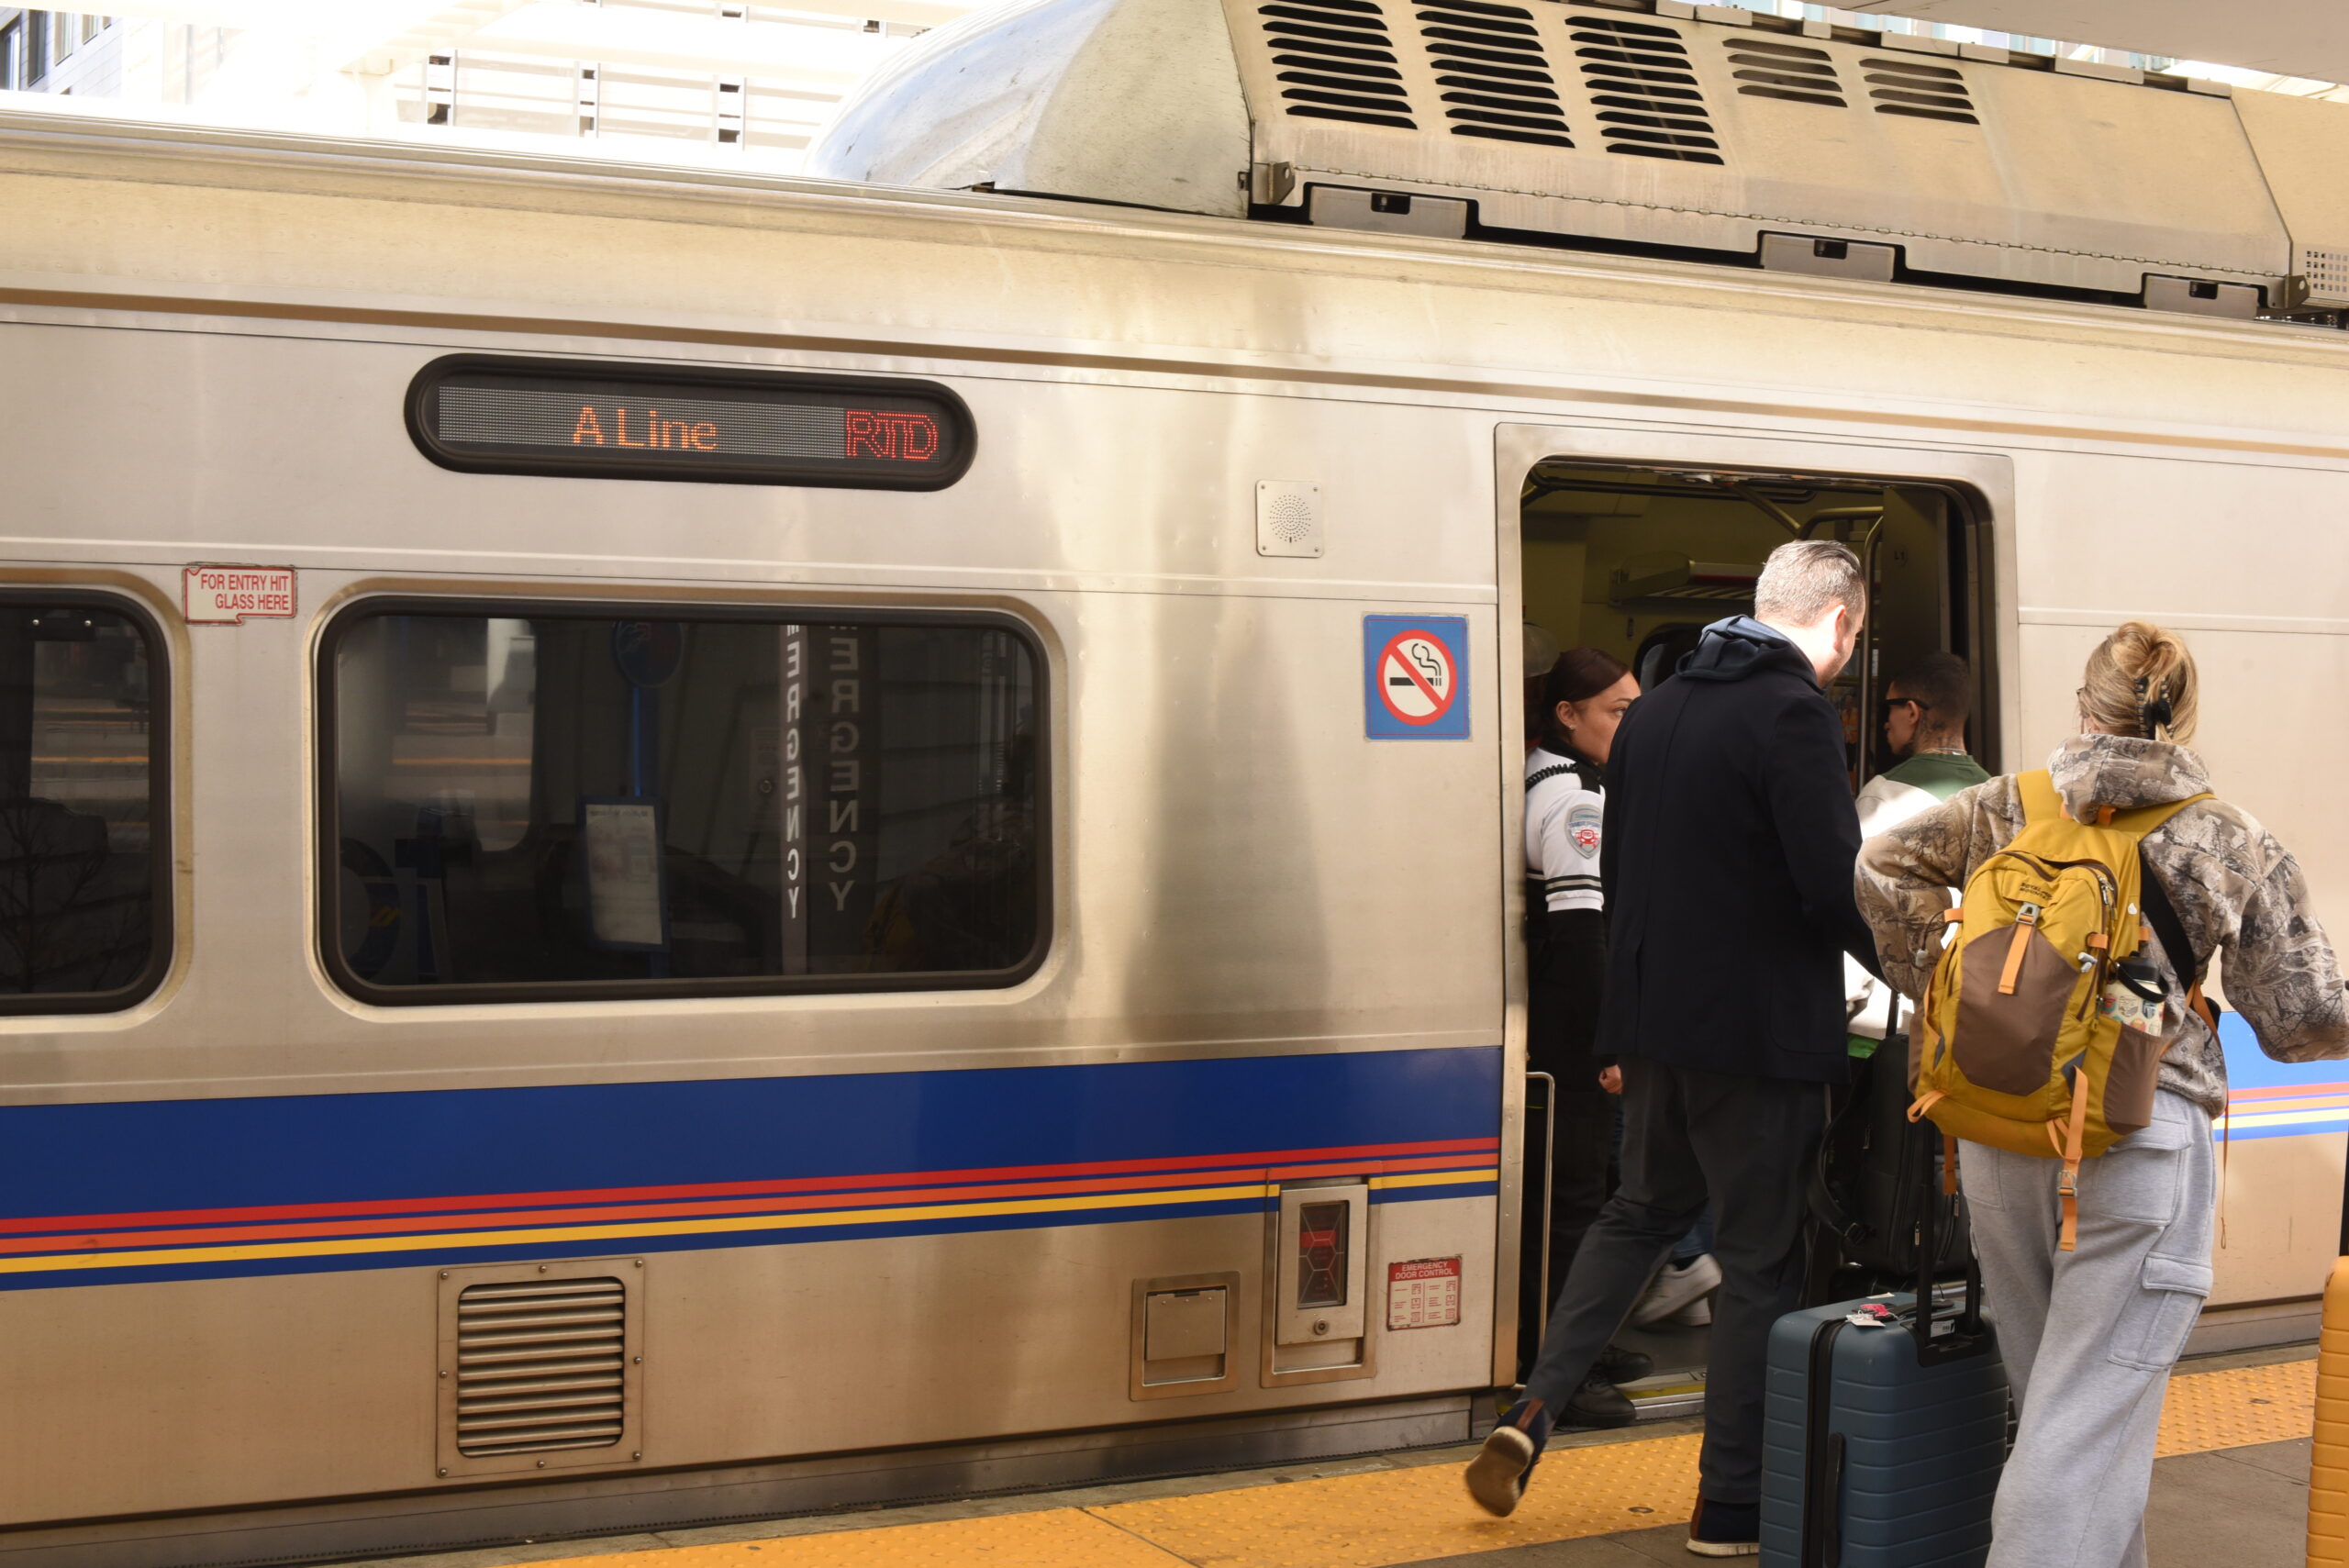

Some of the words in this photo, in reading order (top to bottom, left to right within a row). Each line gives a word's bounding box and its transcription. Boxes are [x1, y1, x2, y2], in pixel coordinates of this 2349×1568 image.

[573, 406, 603, 445] A
[618, 409, 718, 450] Line
[845, 410, 939, 460] RTD
[200, 573, 225, 589] FOR
[228, 574, 267, 591] ENTRY
[270, 575, 289, 591] HIT
[215, 594, 254, 609] GLASS
[258, 595, 289, 610] HERE
[1395, 1271, 1417, 1280] DOOR
[1419, 1268, 1453, 1278] CONTROL
[1401, 1261, 1448, 1272] EMERGENCY
